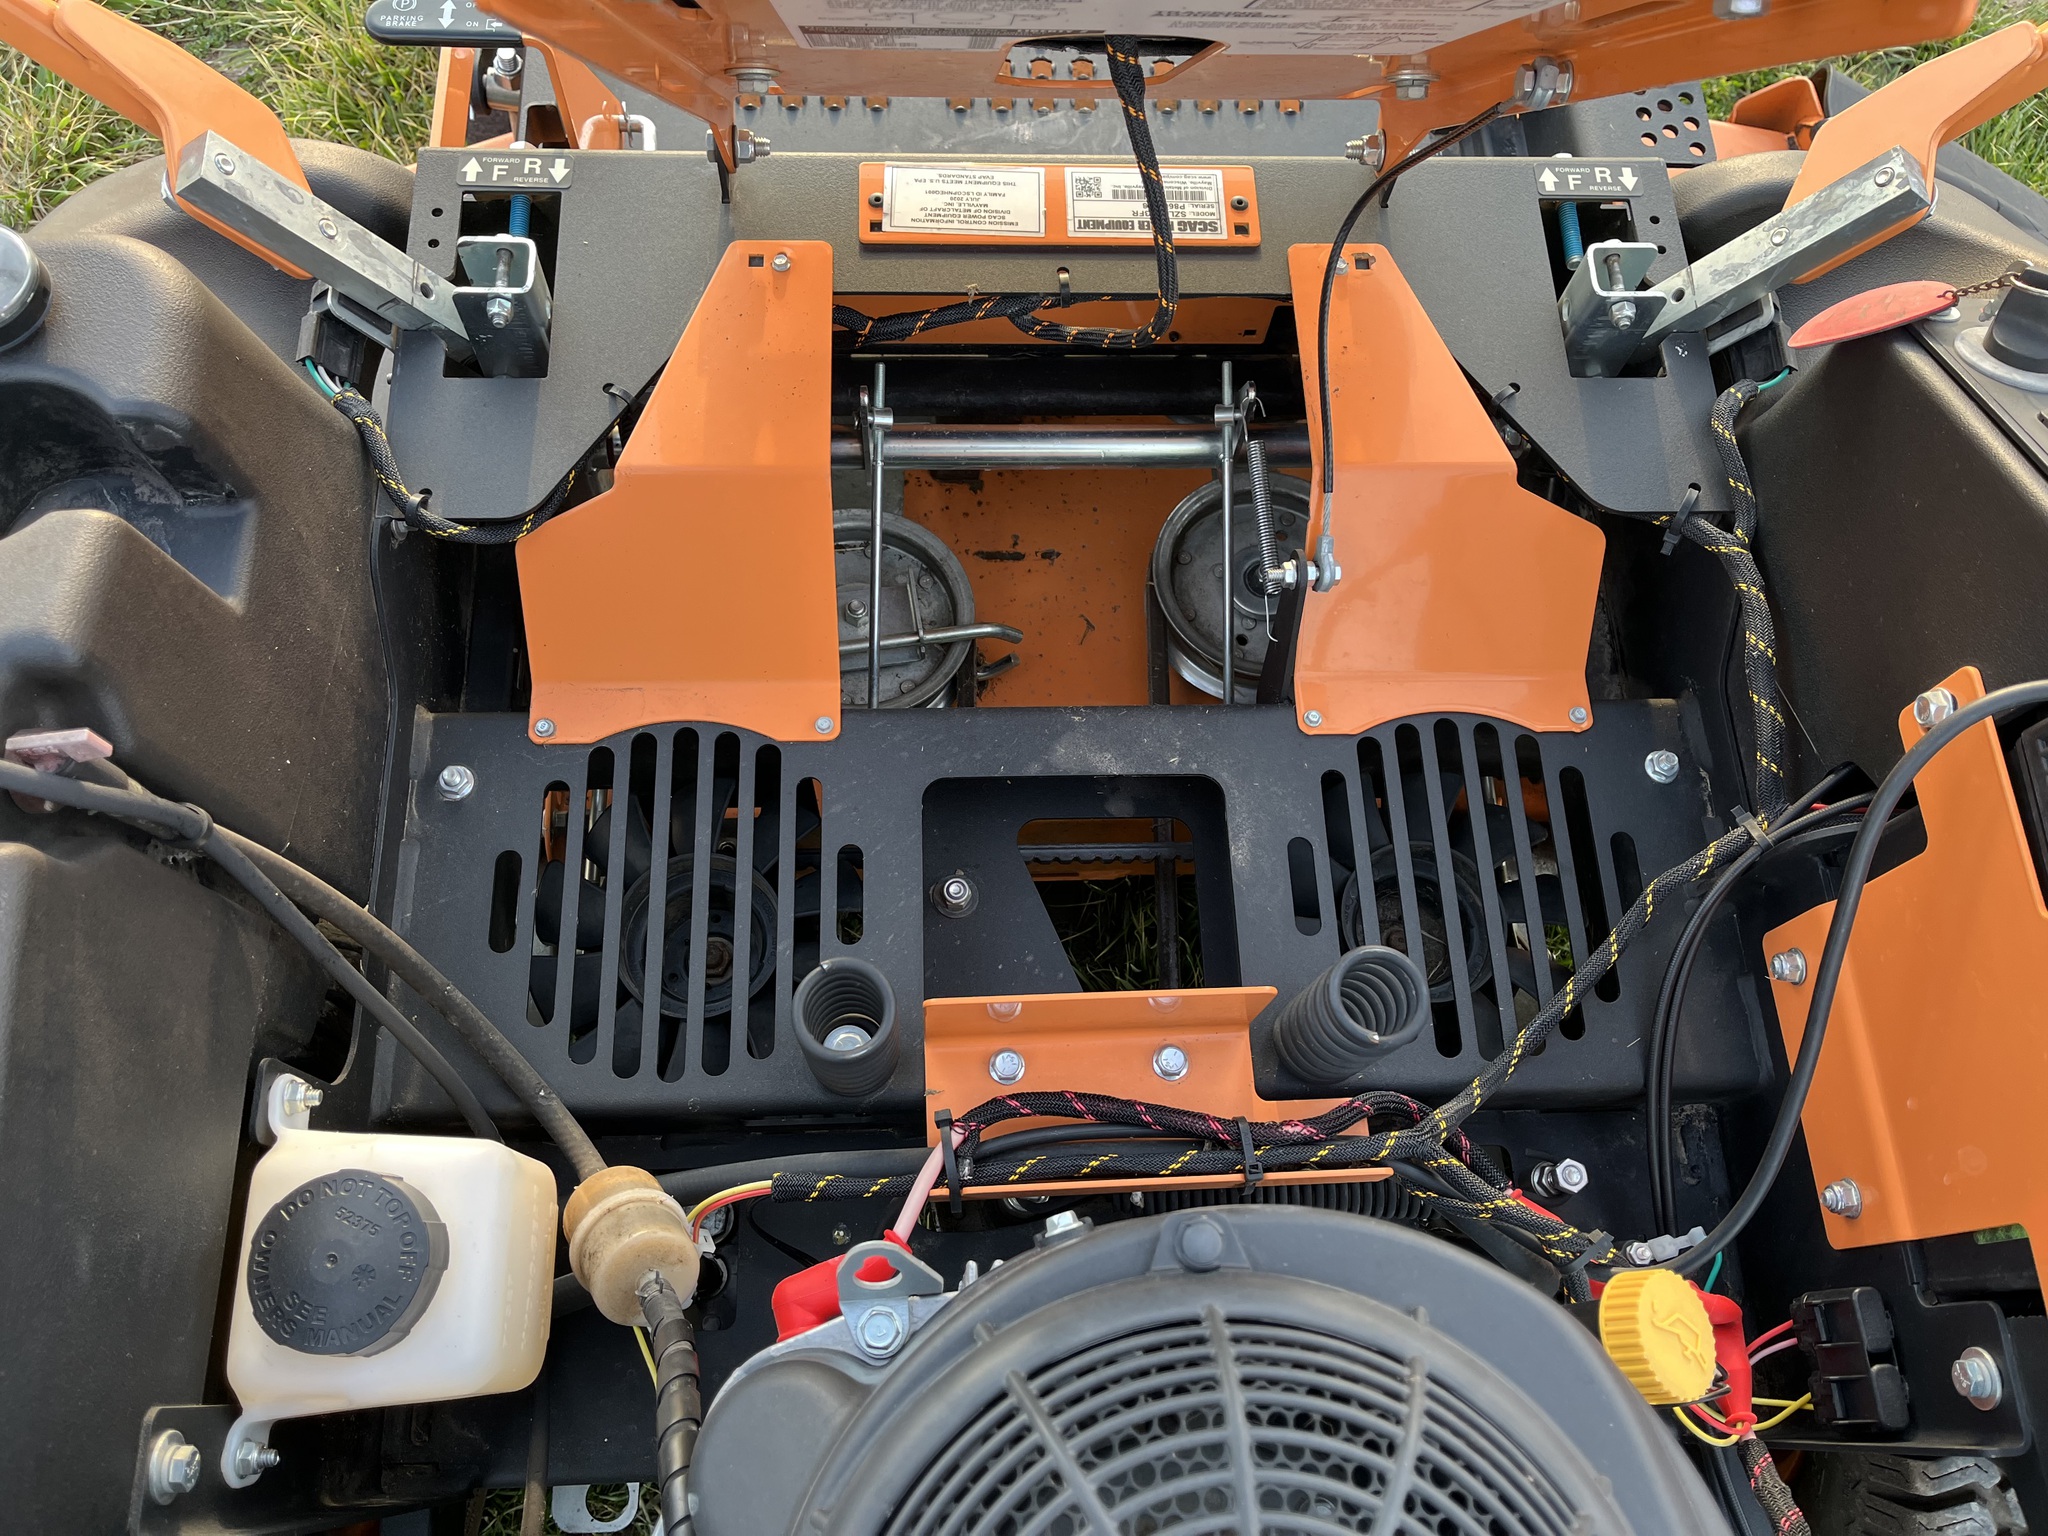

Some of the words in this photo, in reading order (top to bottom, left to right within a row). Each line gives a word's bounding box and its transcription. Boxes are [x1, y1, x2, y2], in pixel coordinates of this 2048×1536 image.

[492, 165, 509, 181] F
[523, 158, 542, 174] R
[513, 176, 549, 184] REVERSE
[1567, 175, 1582, 191] F
[1594, 167, 1613, 183] R
[1076, 219, 1135, 230] EQUIPMENT
[1177, 220, 1218, 232] SCAG
[280, 1189, 315, 1221] DO
[320, 1177, 374, 1200] NOT
[374, 1187, 412, 1228] TOP
[397, 1231, 418, 1282] OFF
[334, 1206, 382, 1237] 52375
[282, 1290, 328, 1325] SEE
[303, 1294, 403, 1348] MANUAL
